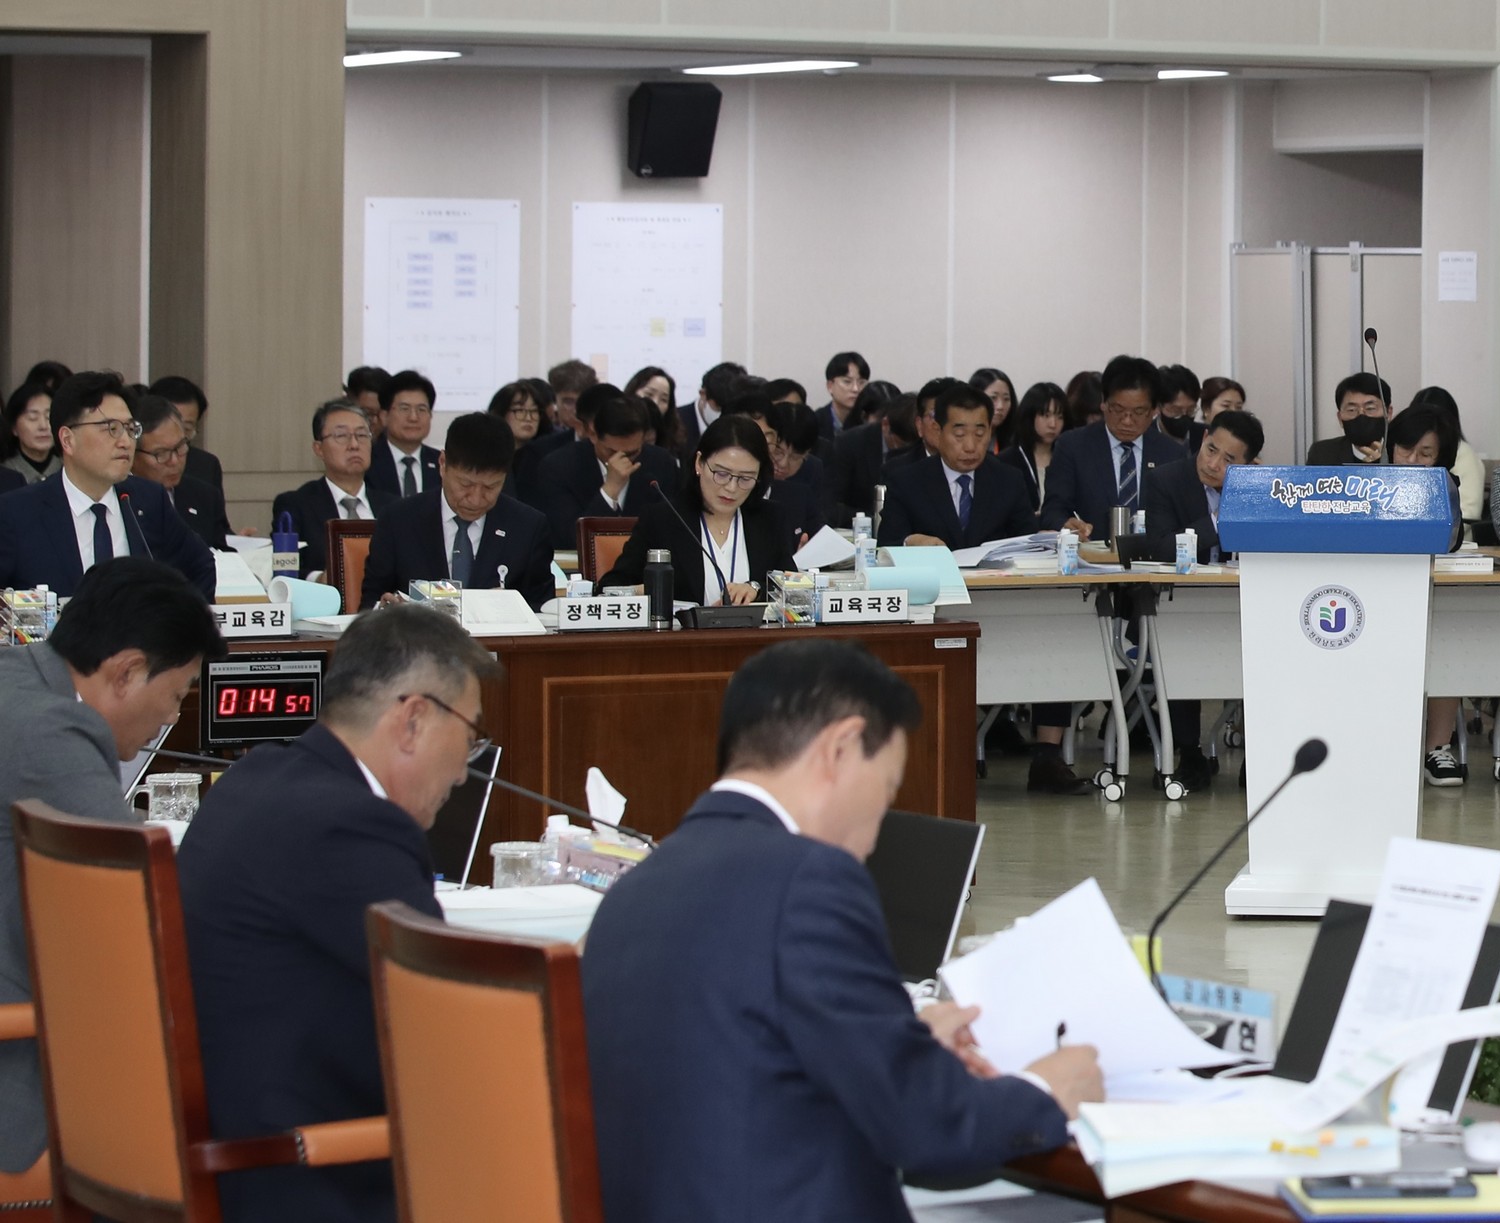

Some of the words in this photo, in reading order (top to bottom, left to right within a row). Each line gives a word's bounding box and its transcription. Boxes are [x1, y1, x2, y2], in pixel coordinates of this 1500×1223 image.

[1333, 501, 1371, 513] 전남교육
[567, 603, 642, 621] 정책국장
[828, 596, 902, 613] 교육국장
[219, 688, 277, 715] 014
[285, 696, 311, 713] 57
